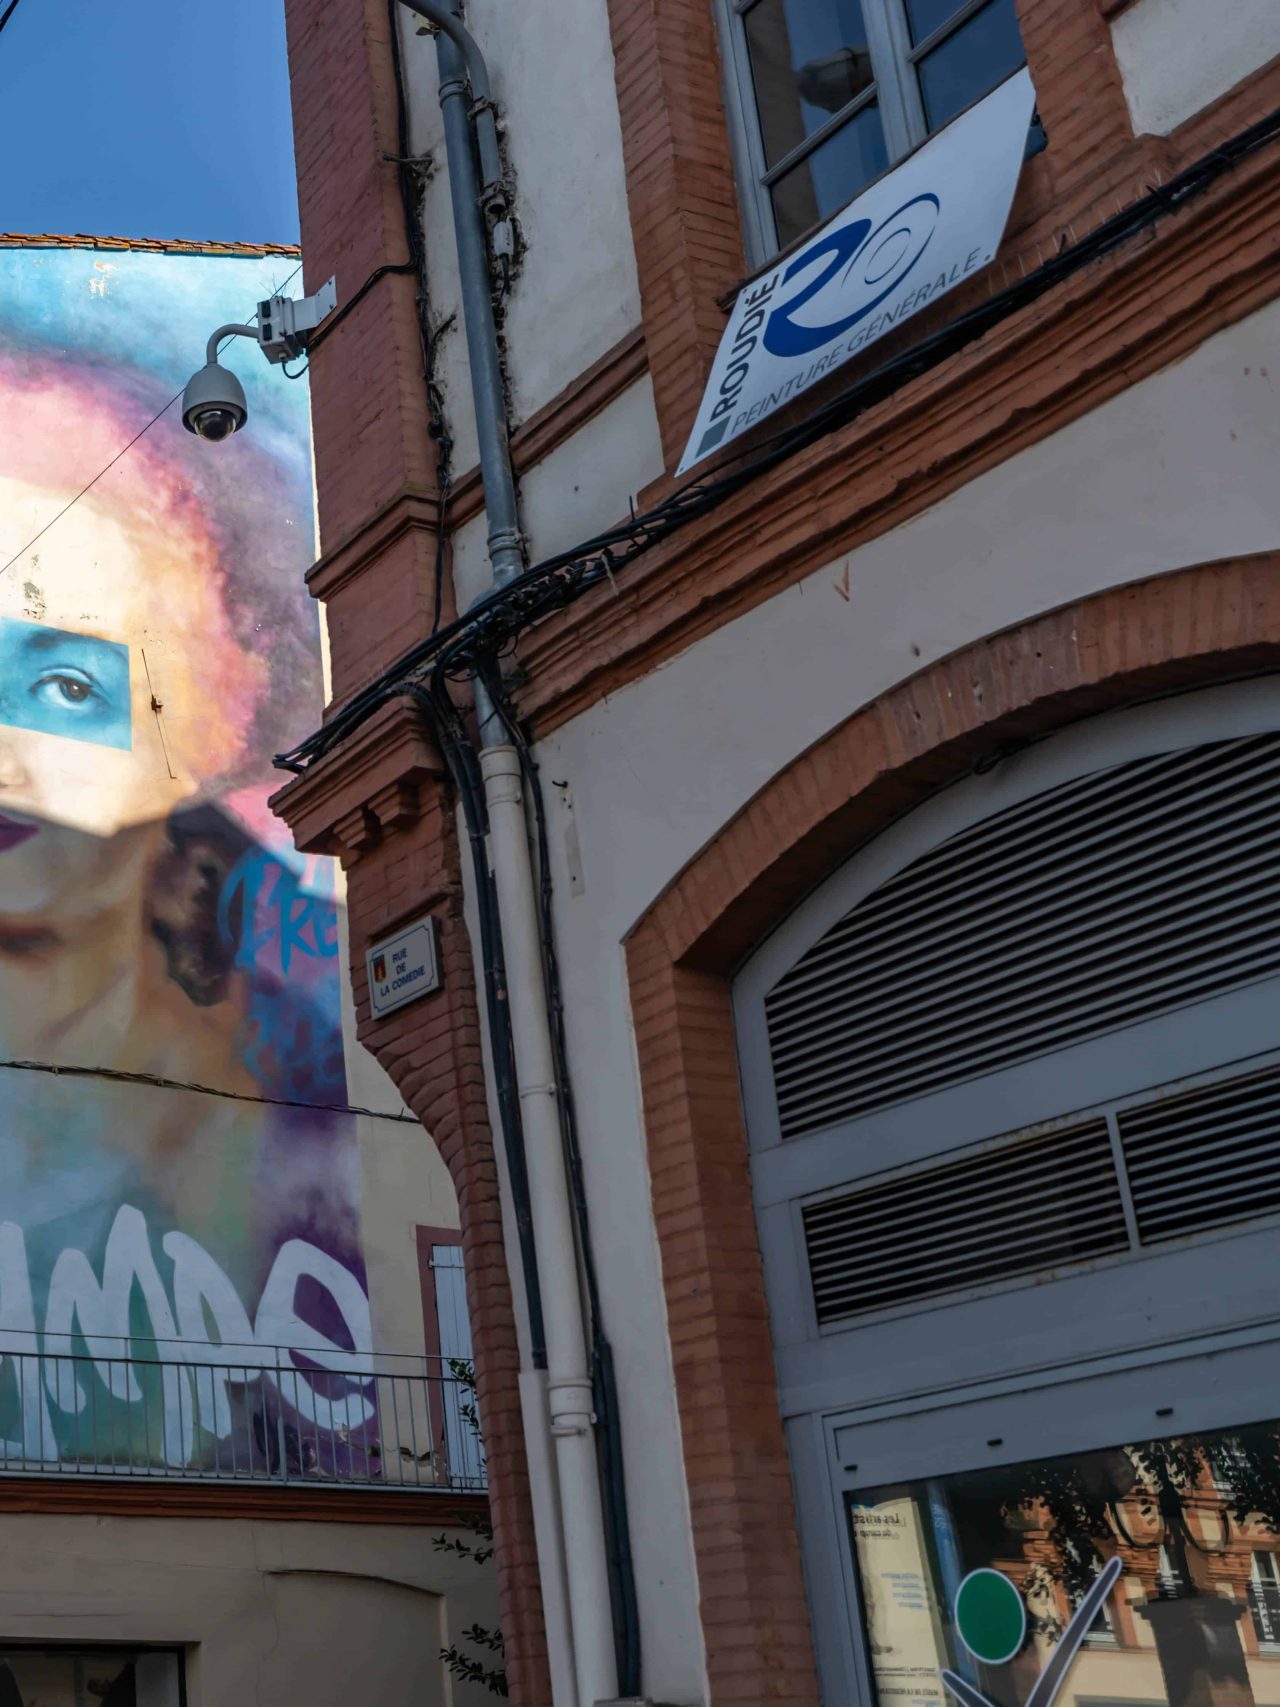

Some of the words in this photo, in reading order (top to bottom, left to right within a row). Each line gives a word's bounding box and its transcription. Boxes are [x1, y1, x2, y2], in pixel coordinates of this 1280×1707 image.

[710, 273, 779, 422] ROUDIÉ
[731, 343, 843, 434] PEINTURE
[847, 247, 981, 352] GÉNÉRALE
[392, 948, 407, 962] RUE
[396, 963, 406, 975] DE
[380, 985, 390, 997] LA
